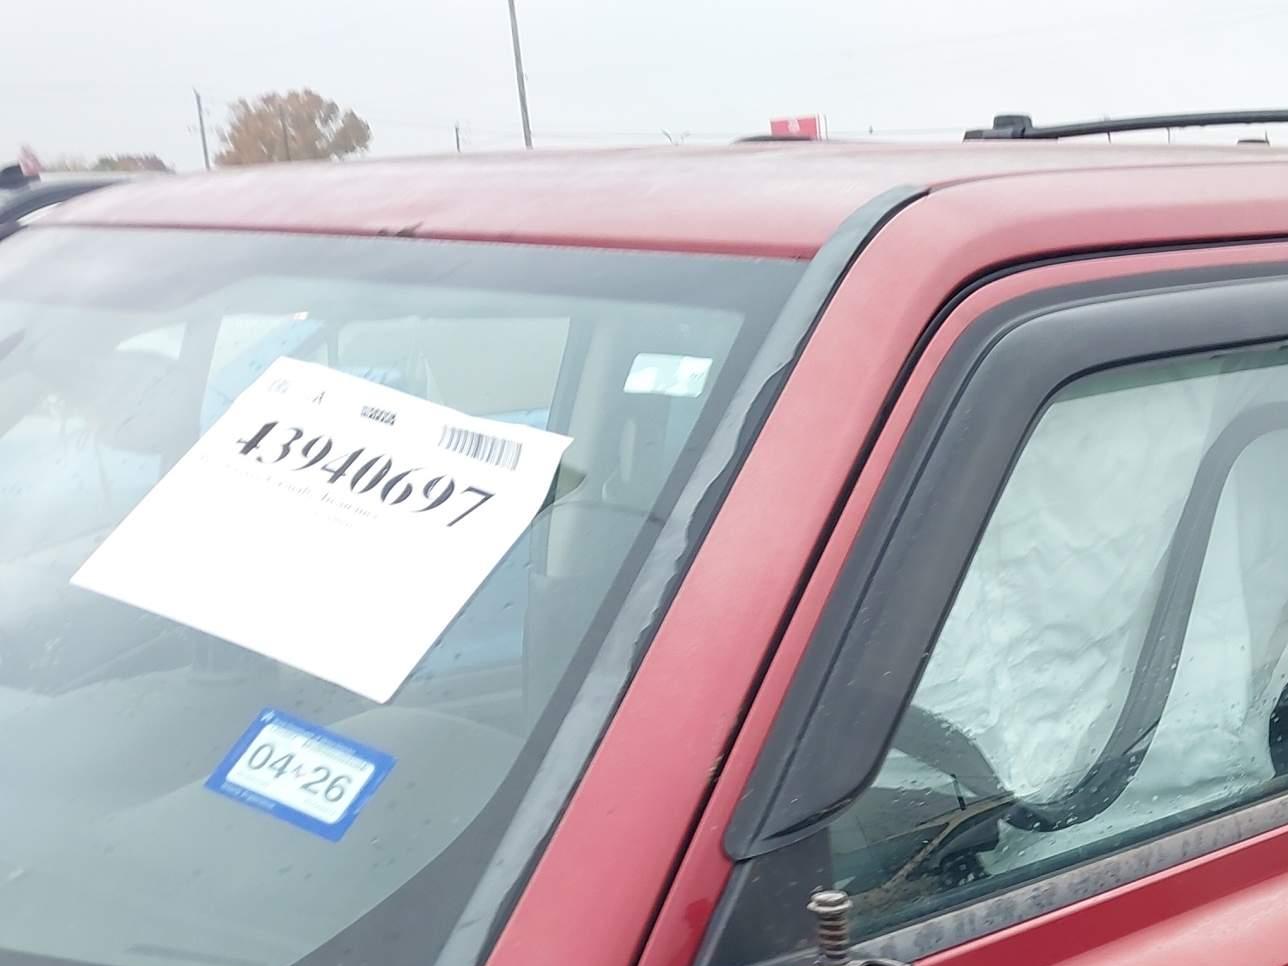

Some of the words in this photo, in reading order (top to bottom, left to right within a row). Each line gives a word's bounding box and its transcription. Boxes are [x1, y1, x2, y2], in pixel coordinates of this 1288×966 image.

[236, 420, 496, 528] 43940697
[246, 742, 296, 780] 04
[300, 765, 353, 803] 26
